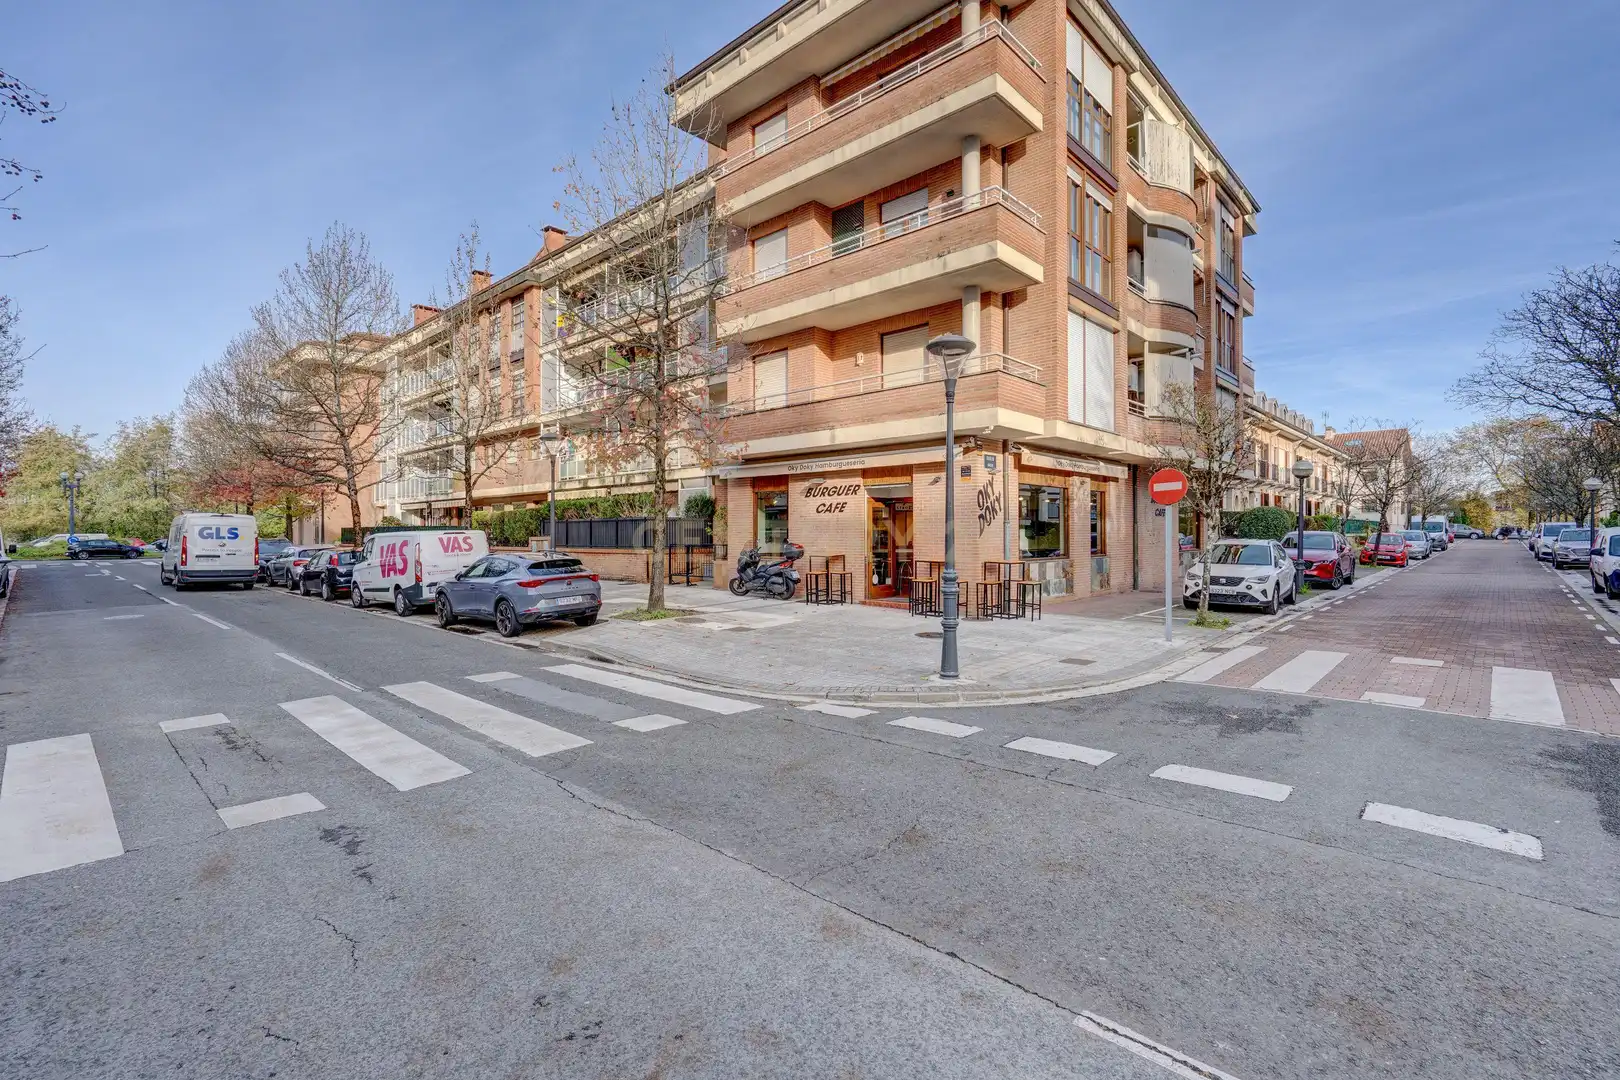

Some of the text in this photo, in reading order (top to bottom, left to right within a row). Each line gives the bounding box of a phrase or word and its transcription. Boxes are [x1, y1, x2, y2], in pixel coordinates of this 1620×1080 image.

[804, 484, 861, 498] BURGUER
[976, 475, 995, 511] OKY
[815, 502, 848, 514] CAFE
[977, 490, 1002, 539] DOKY
[438, 535, 474, 553] VAS
[379, 539, 409, 578] VAS
